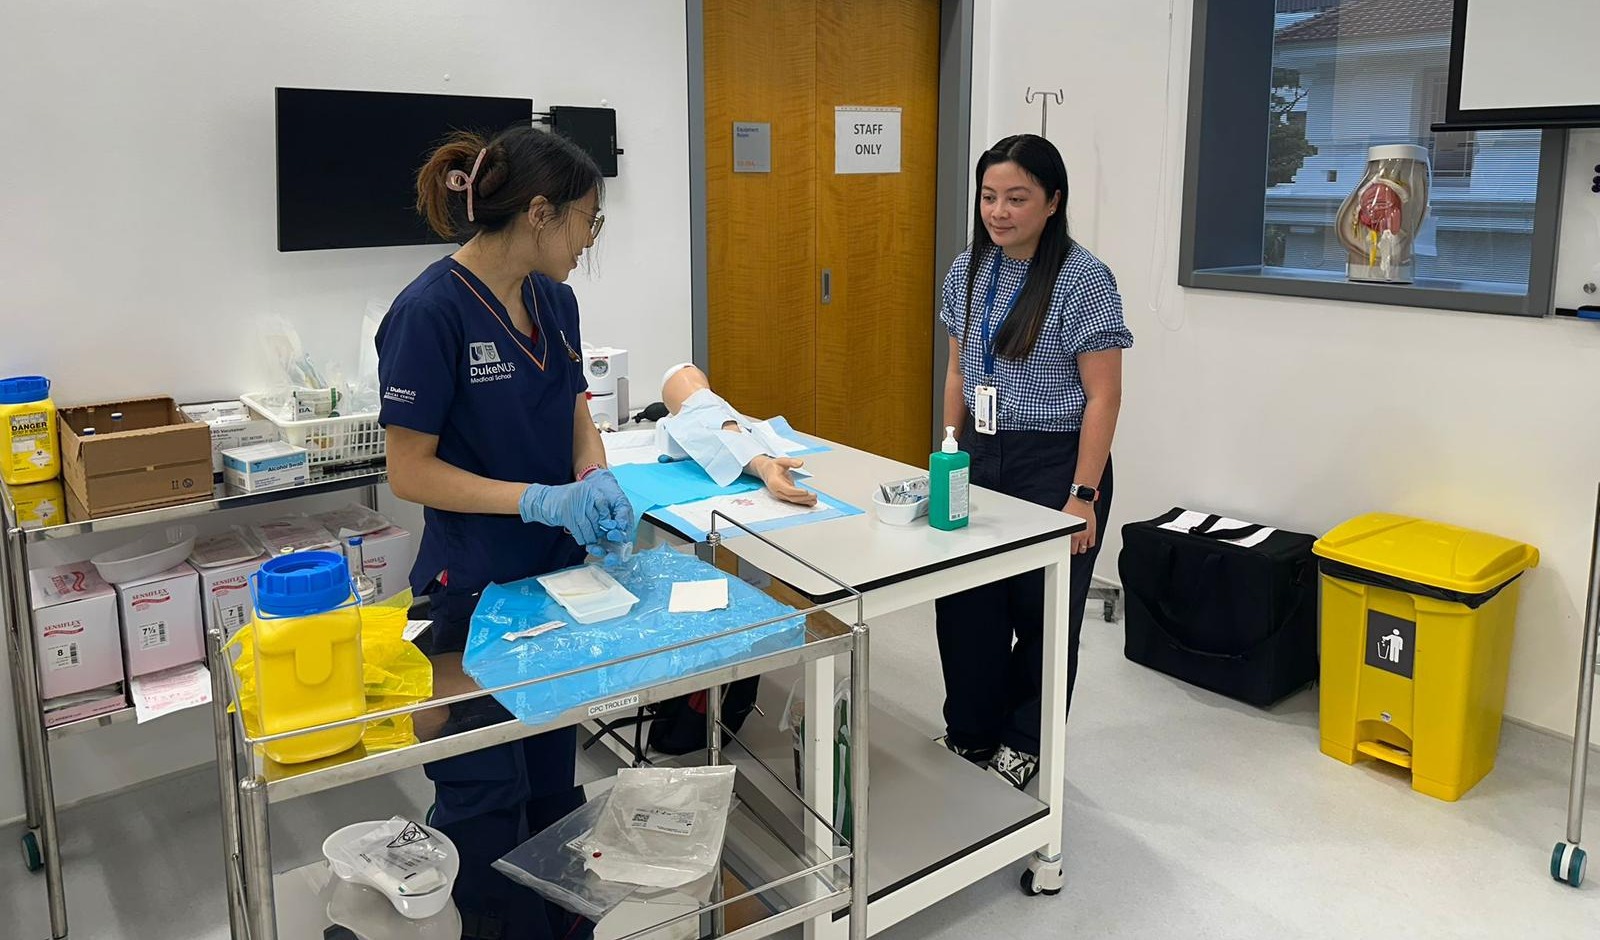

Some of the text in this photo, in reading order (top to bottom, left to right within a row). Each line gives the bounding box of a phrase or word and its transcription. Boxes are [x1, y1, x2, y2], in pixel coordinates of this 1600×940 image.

[853, 123, 883, 135] STAFF
[855, 143, 882, 155] ONLY
[470, 362, 516, 377] DukeNUS
[470, 373, 512, 384] Medical School
[12, 422, 47, 431] DANGER
[268, 464, 288, 472] Alcohol
[212, 575, 246, 586] SENSIFLEX
[132, 588, 168, 600] SENSIFLEX
[228, 609, 234, 617] 7
[44, 620, 82, 632] SENSIFLEX
[57, 649, 64, 657] 8
[590, 706, 604, 714] CPC
[605, 698, 632, 710] TROLLEY
